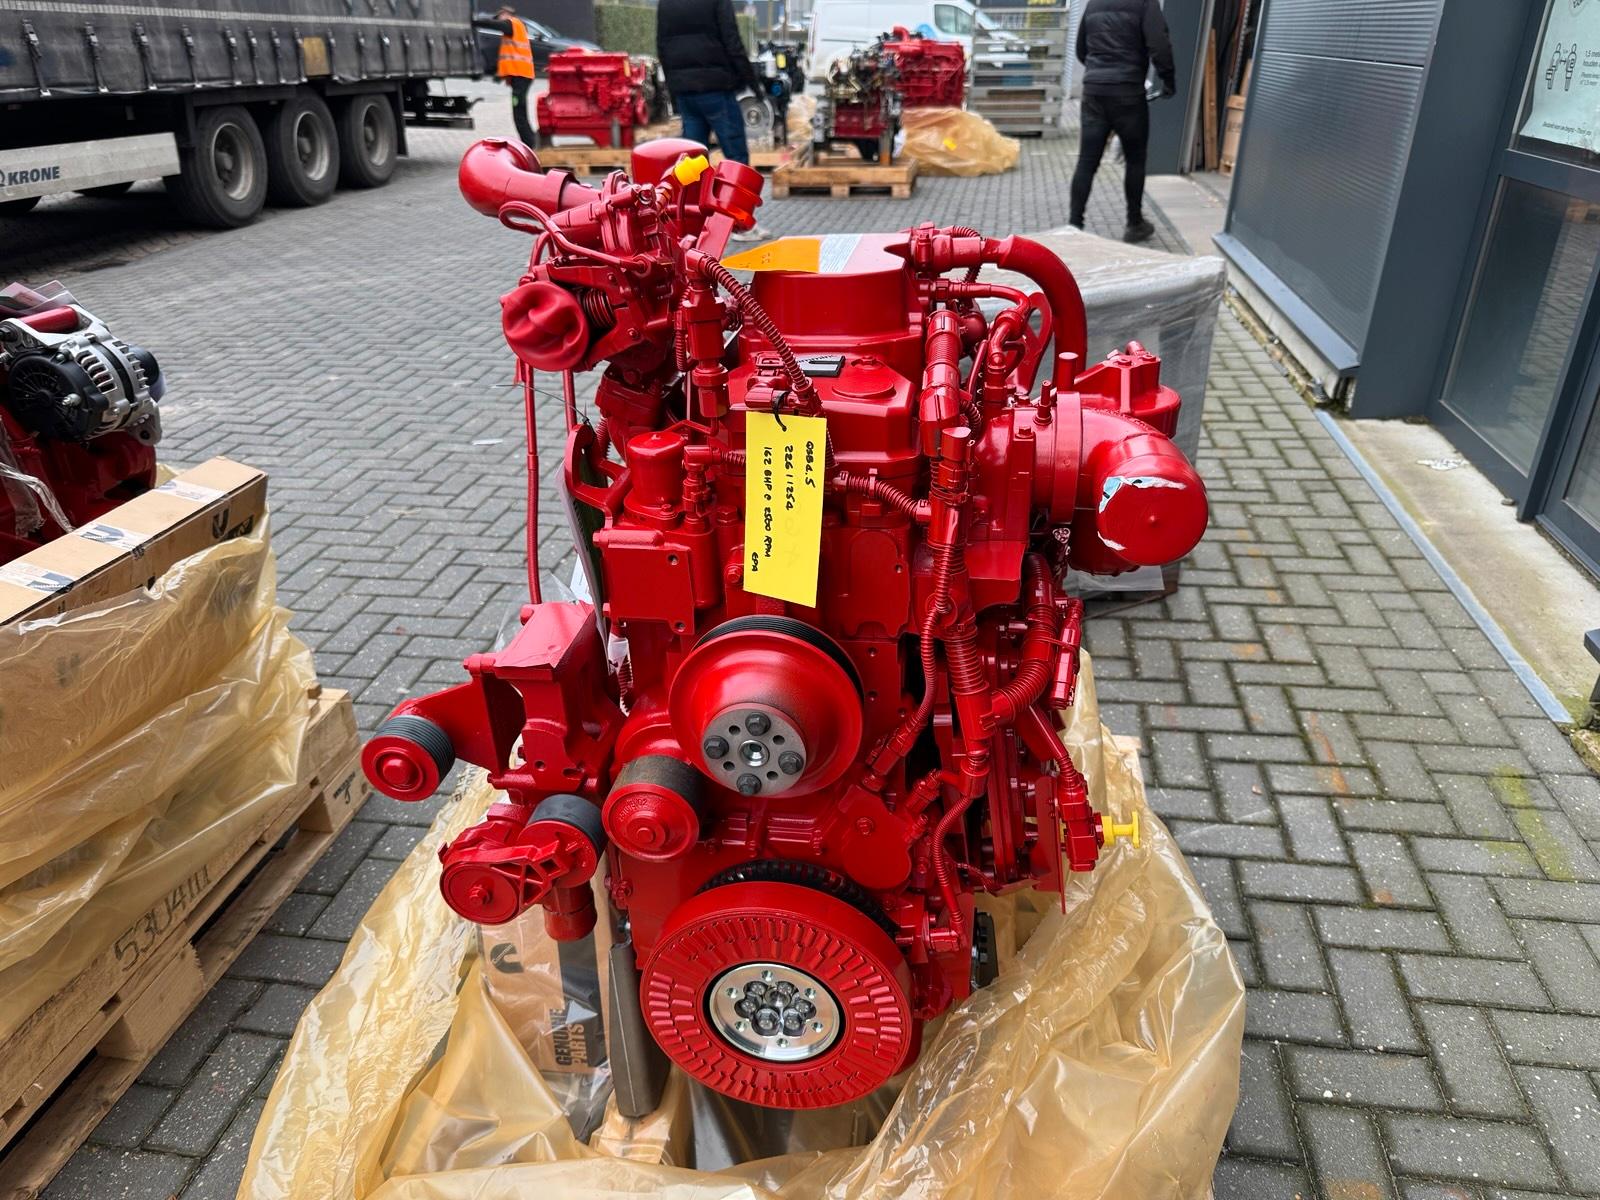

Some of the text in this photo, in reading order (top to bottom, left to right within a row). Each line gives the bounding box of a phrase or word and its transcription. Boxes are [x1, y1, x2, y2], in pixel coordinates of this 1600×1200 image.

[8, 166, 61, 186] KRONE
[763, 446, 773, 466] 162
[763, 469, 773, 491] BHP
[763, 507, 773, 532] 2500
[763, 535, 773, 558] RPM
[751, 551, 759, 572] EPA
[567, 1023, 588, 1066] PARTS
